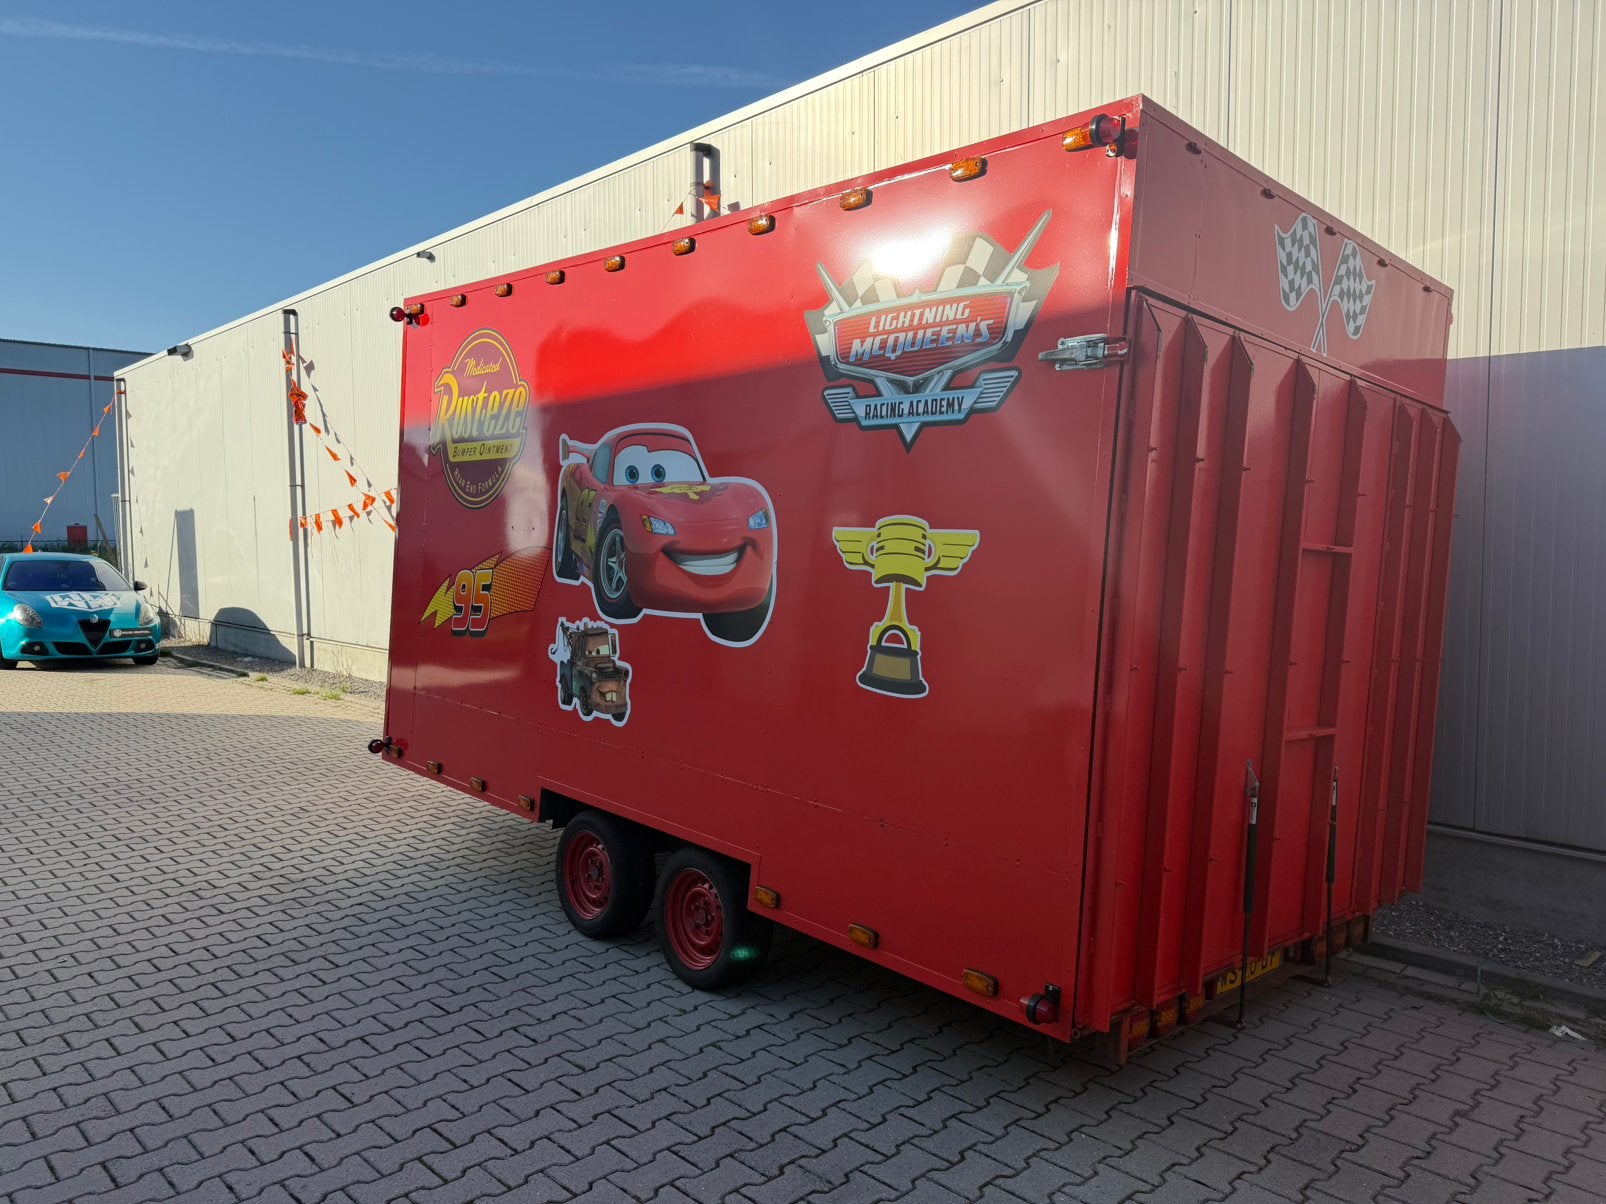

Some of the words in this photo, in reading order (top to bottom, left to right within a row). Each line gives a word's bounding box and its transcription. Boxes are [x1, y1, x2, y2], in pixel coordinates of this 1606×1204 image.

[868, 301, 970, 333] LIGHTNING
[848, 316, 994, 363] MCQUEEN'S
[464, 356, 503, 377] Medicated
[864, 401, 904, 420] RACING
[907, 396, 965, 417] ACADEMY
[451, 569, 493, 638] 95
